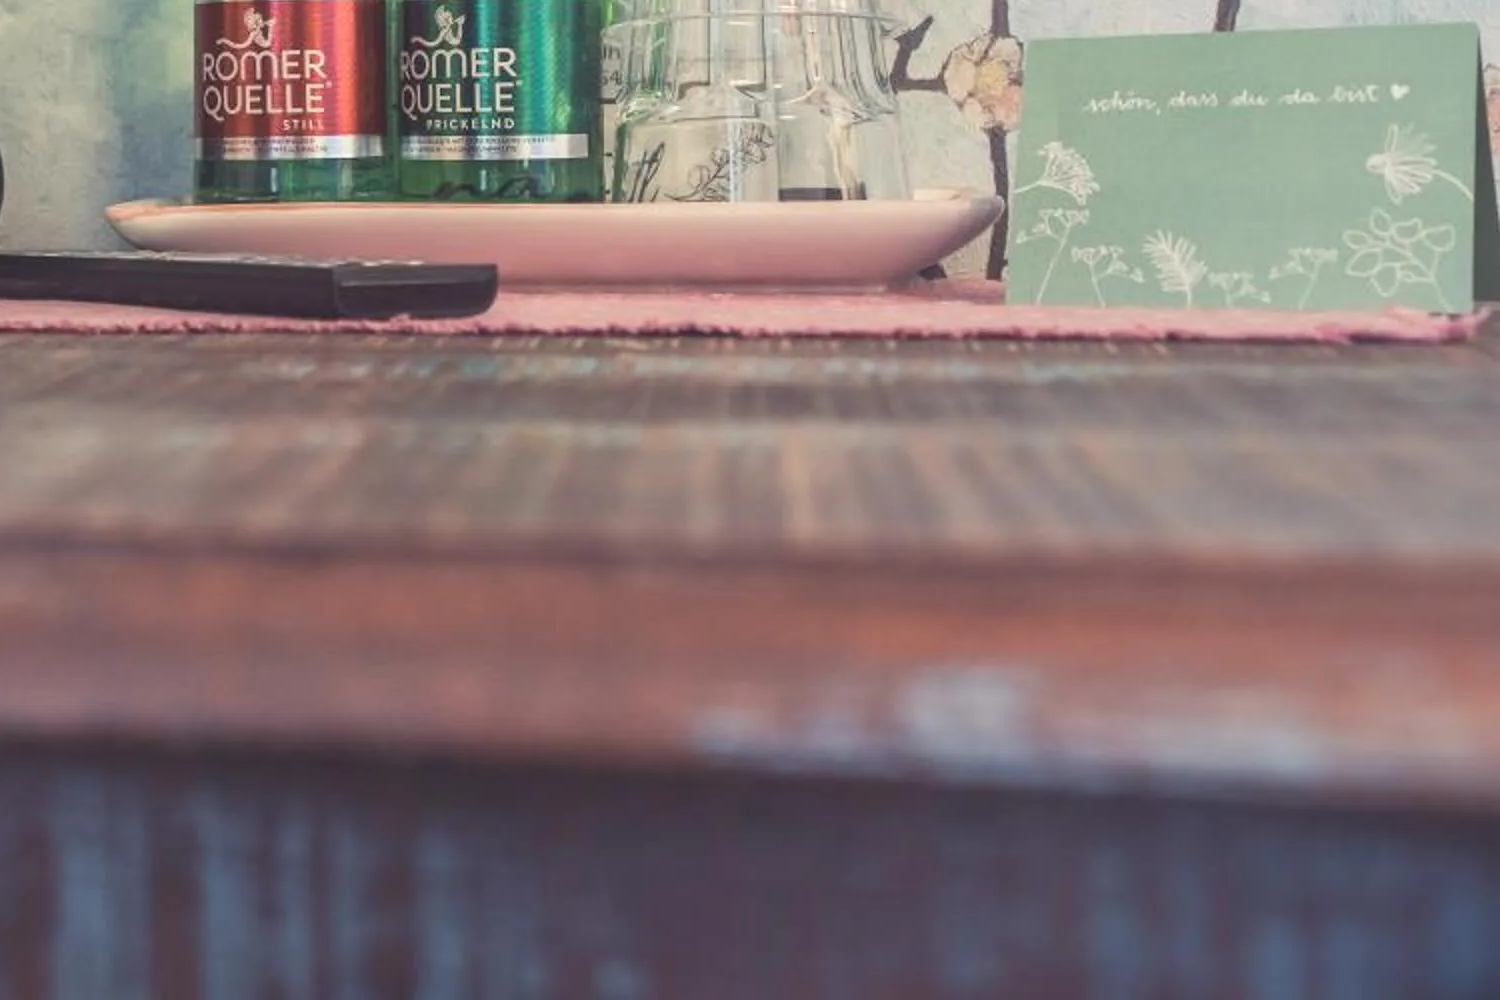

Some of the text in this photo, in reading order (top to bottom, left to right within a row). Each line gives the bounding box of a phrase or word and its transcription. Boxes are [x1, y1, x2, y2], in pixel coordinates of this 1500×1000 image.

[203, 83, 325, 122] QUELLE
[401, 81, 516, 121] QUELLE
[282, 119, 325, 132] STILL
[426, 117, 516, 131] PRICKELND
